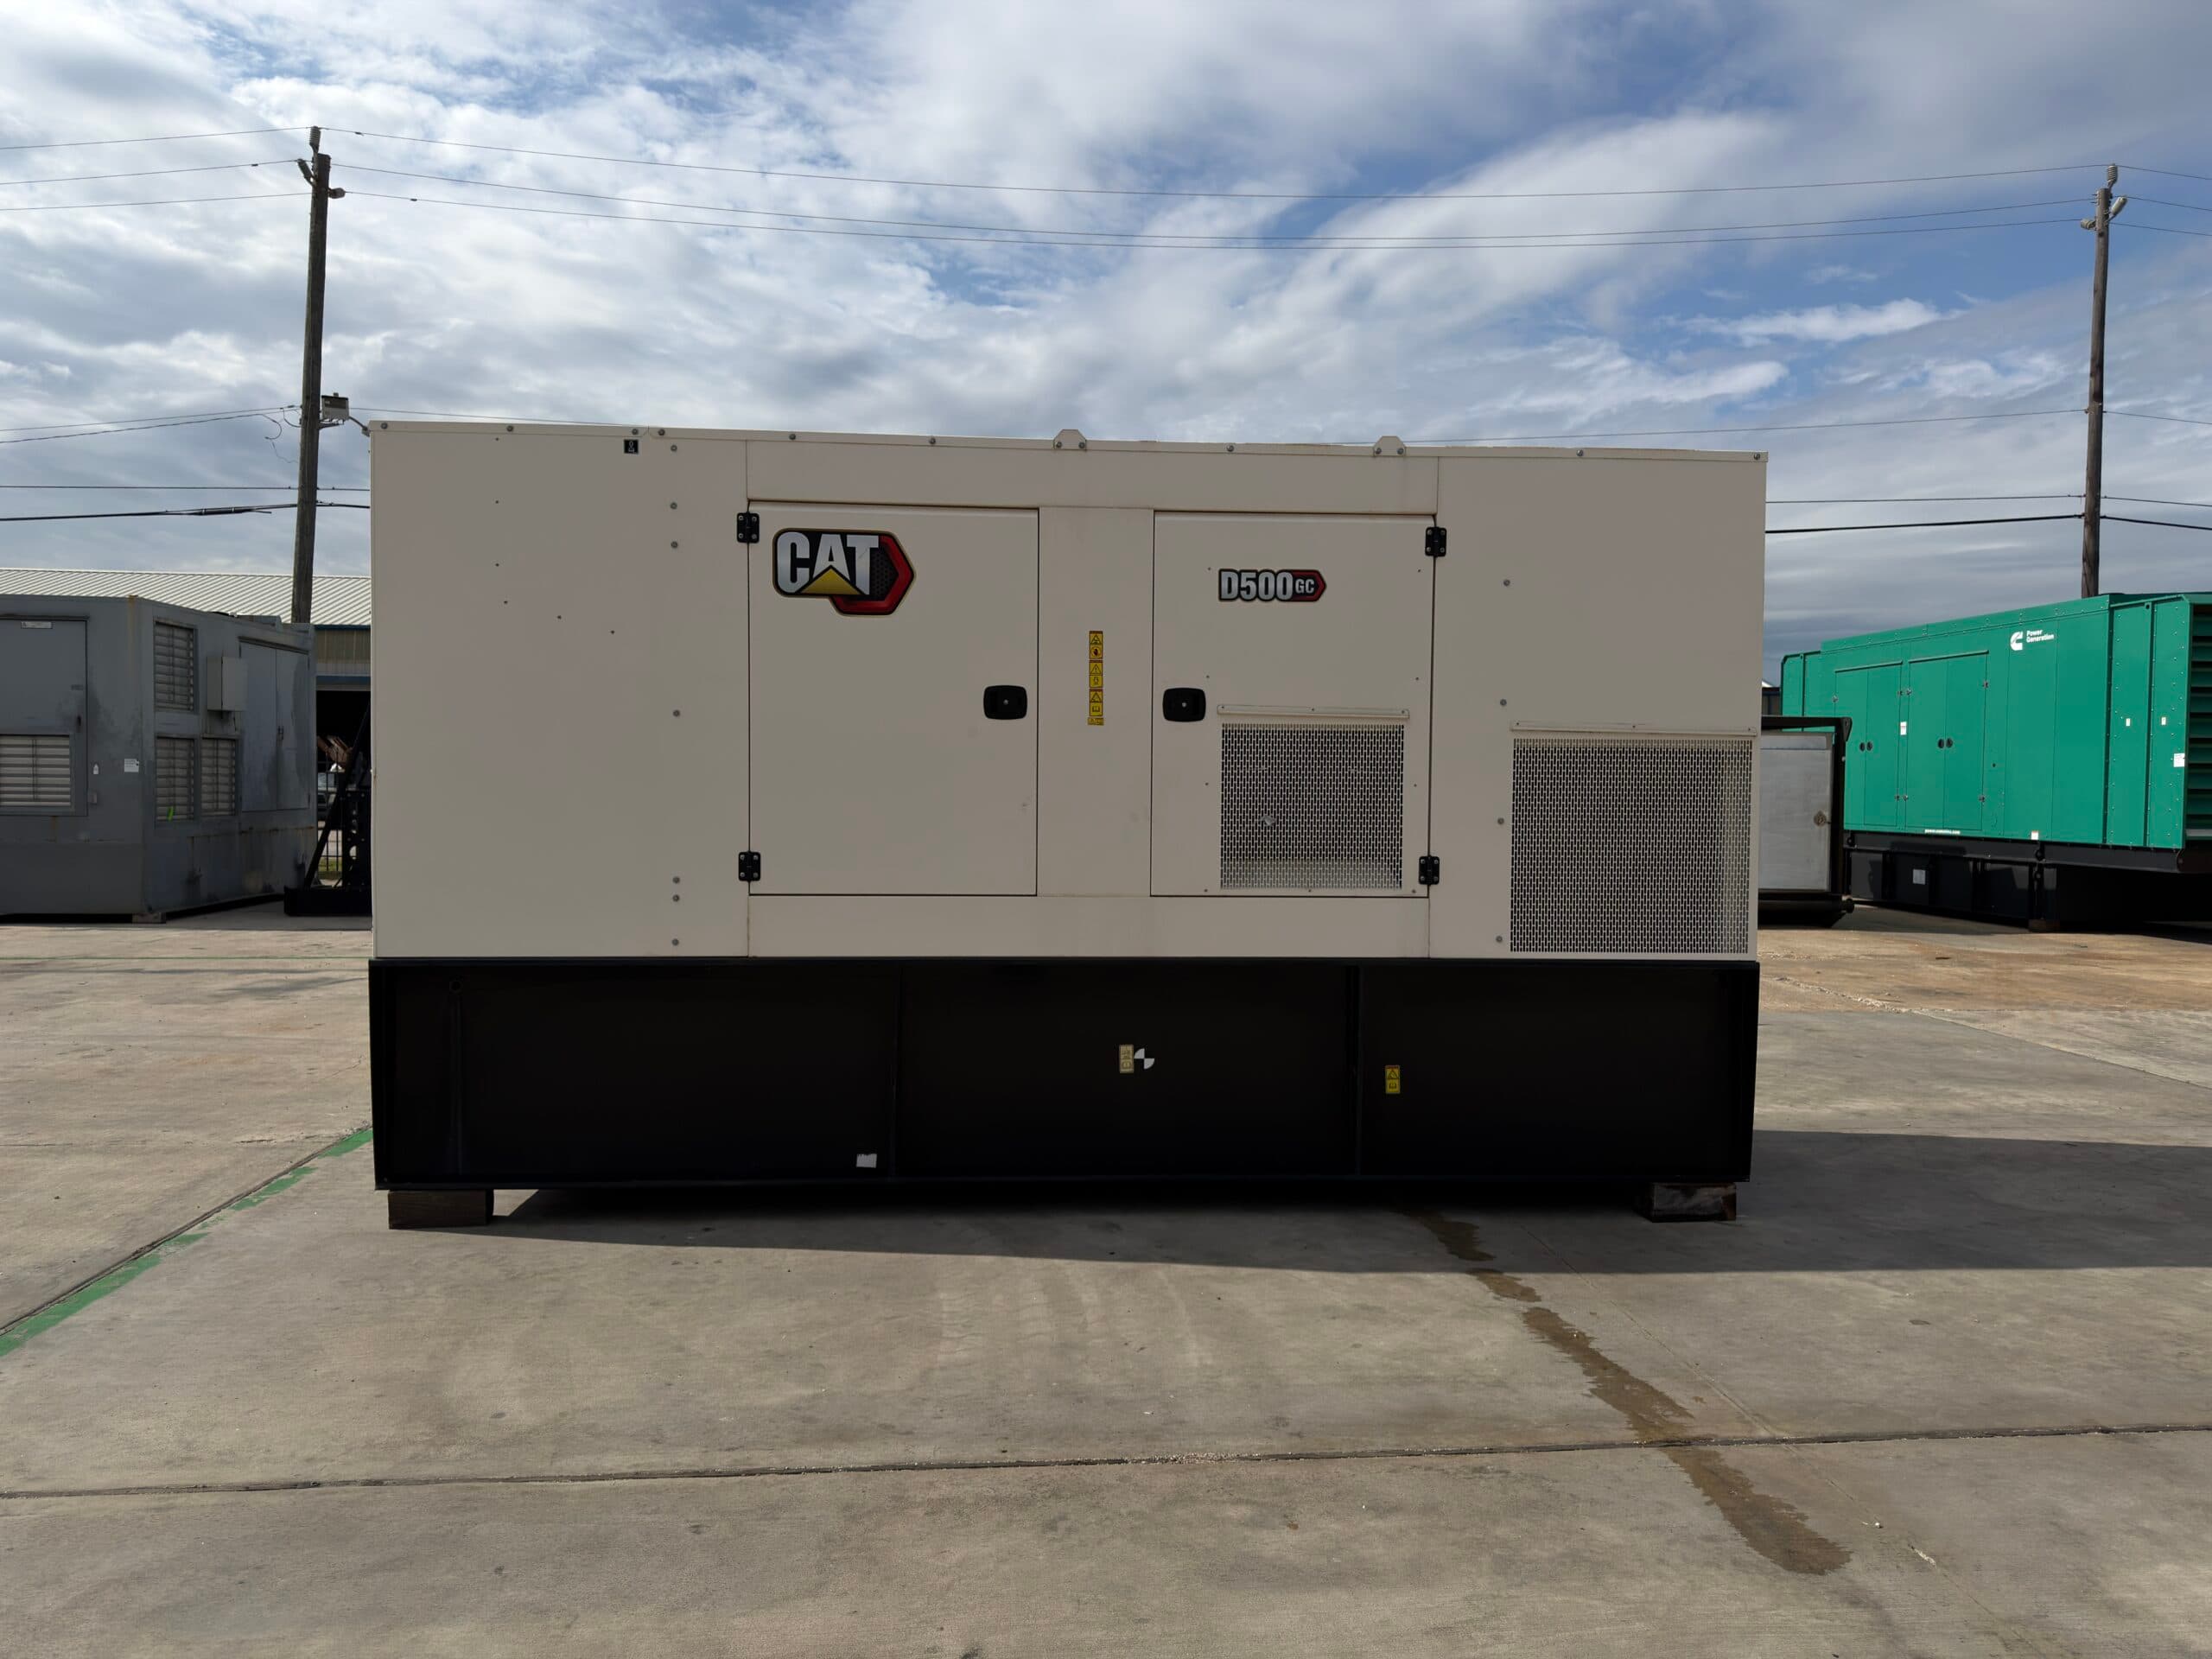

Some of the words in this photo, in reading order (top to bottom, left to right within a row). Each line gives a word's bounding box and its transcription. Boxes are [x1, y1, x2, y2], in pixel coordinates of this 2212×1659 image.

[776, 531, 880, 596] CAT
[1220, 570, 1294, 601] D500
[1294, 578, 1315, 594] GC
[2026, 634, 2054, 643] Generation
